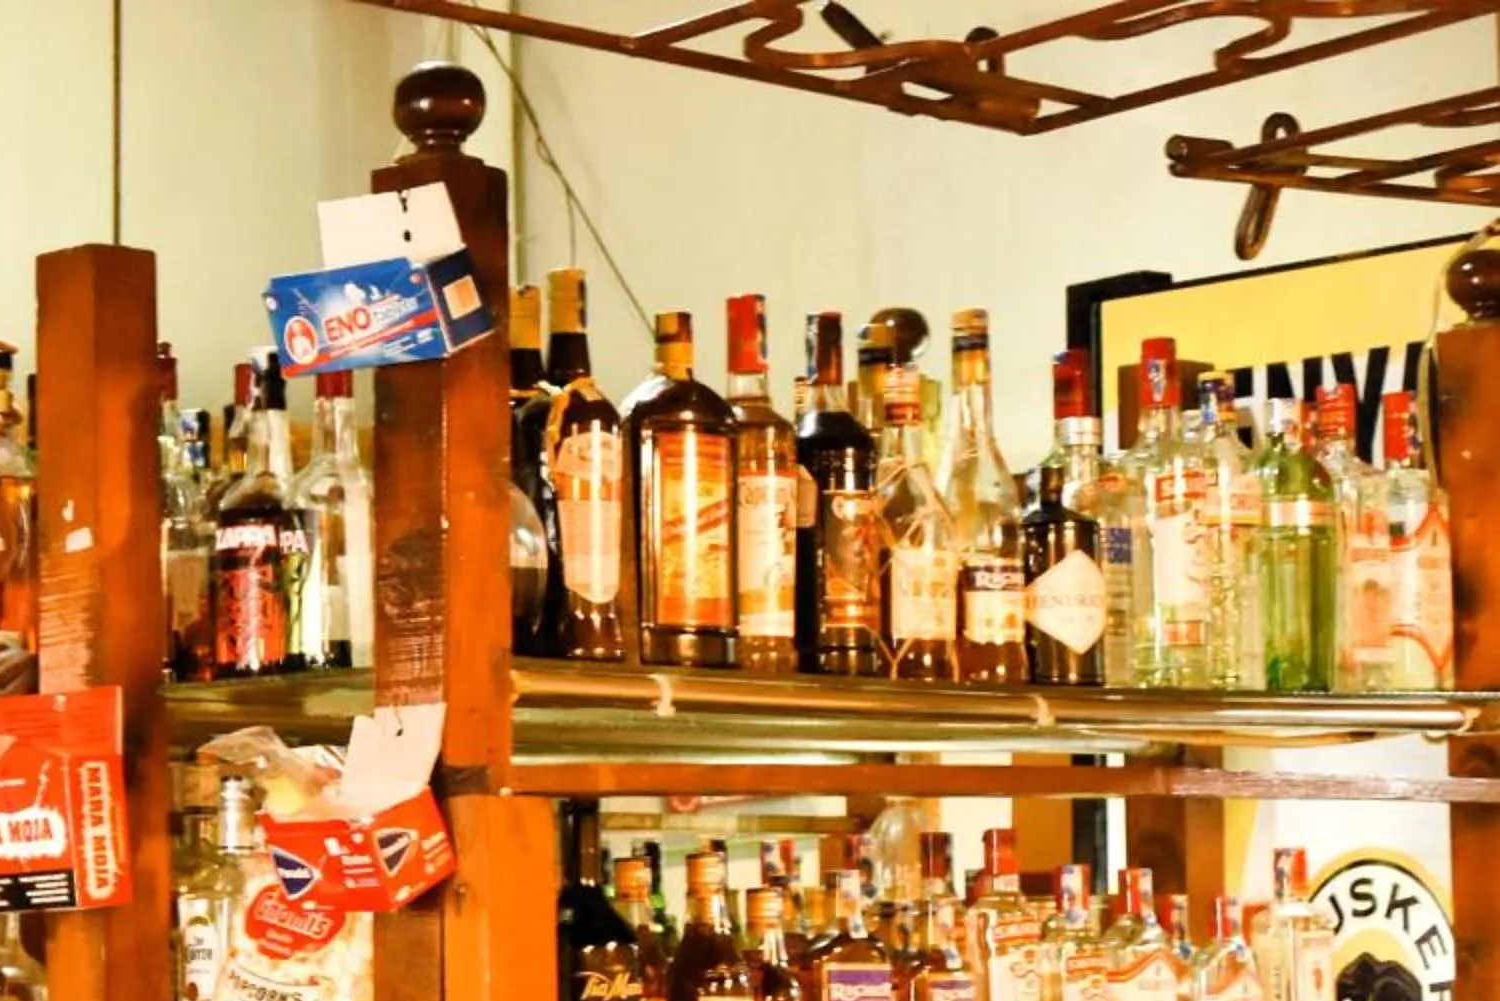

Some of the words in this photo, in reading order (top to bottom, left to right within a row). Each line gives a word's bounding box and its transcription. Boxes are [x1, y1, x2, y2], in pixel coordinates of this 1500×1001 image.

[323, 305, 371, 342] ENO
[86, 766, 106, 828] MARA
[7, 816, 53, 843] MOJA
[92, 834, 111, 889] MOJA
